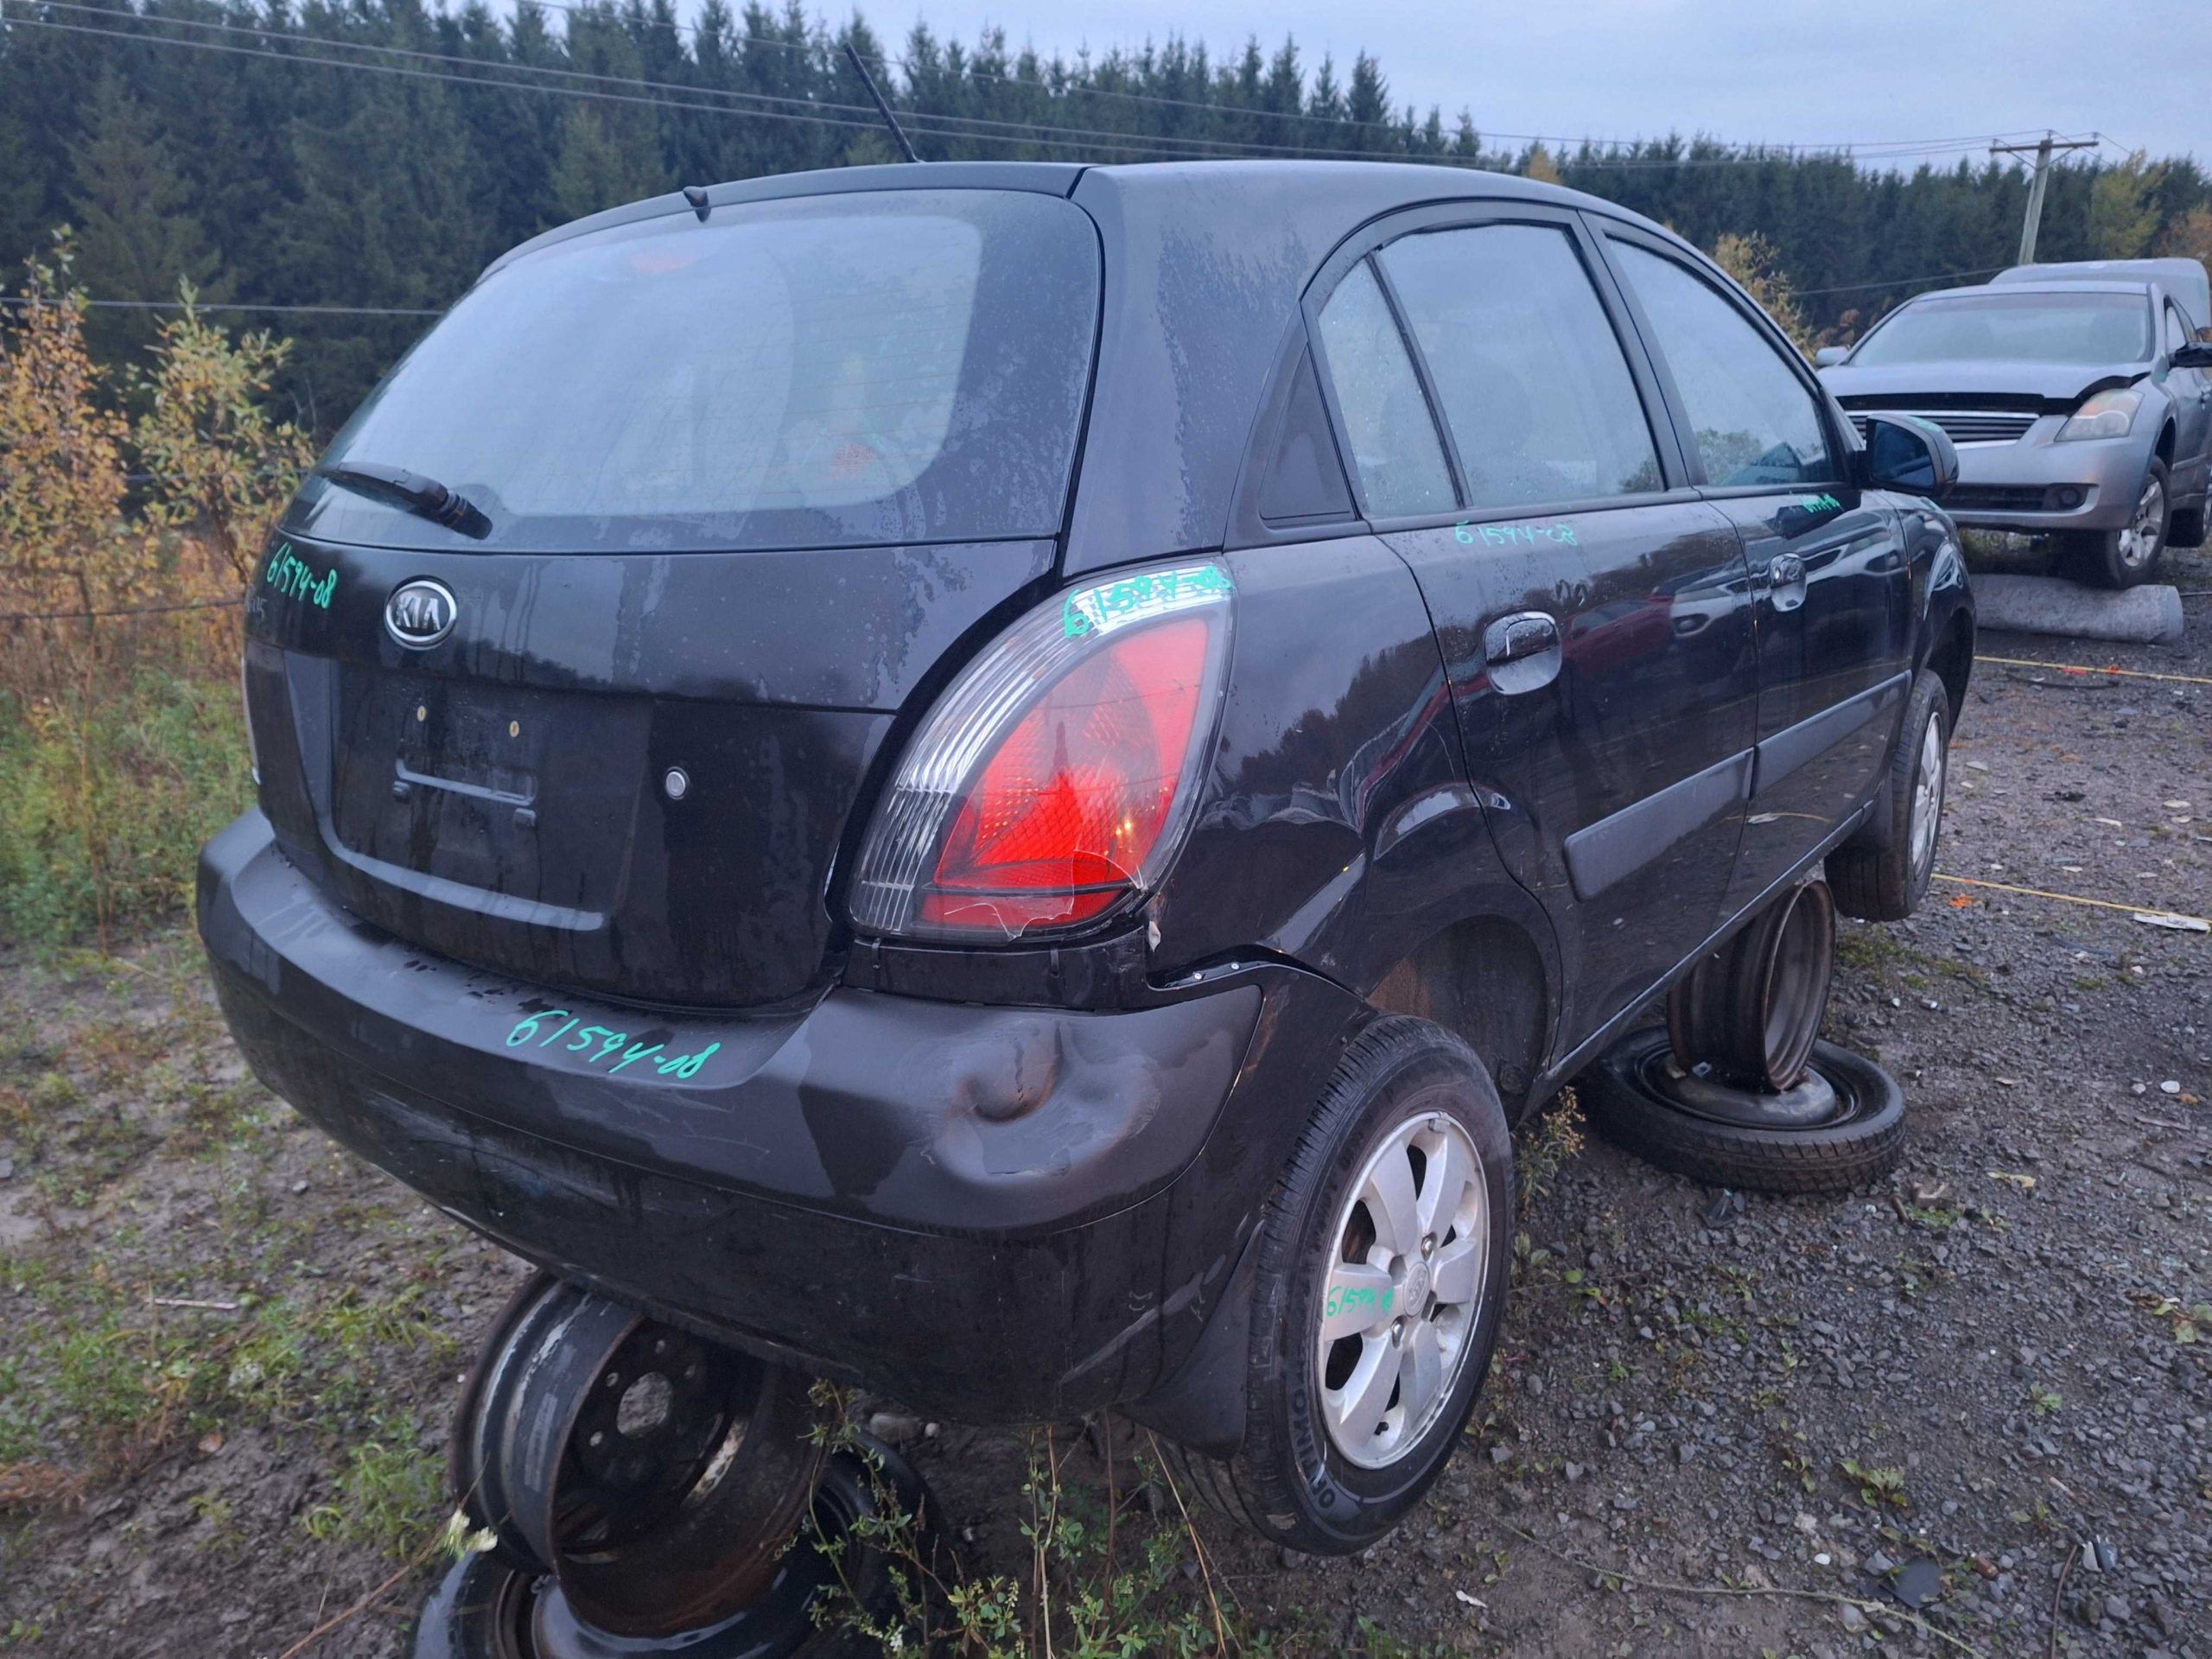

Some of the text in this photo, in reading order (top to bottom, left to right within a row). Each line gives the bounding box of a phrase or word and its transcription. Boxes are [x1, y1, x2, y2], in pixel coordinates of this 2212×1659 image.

[267, 542, 338, 608] 61594-08
[397, 596, 442, 631] KIA
[505, 1010, 721, 1079] 61594-08
[1293, 1389, 1336, 1509] OPTIMO
